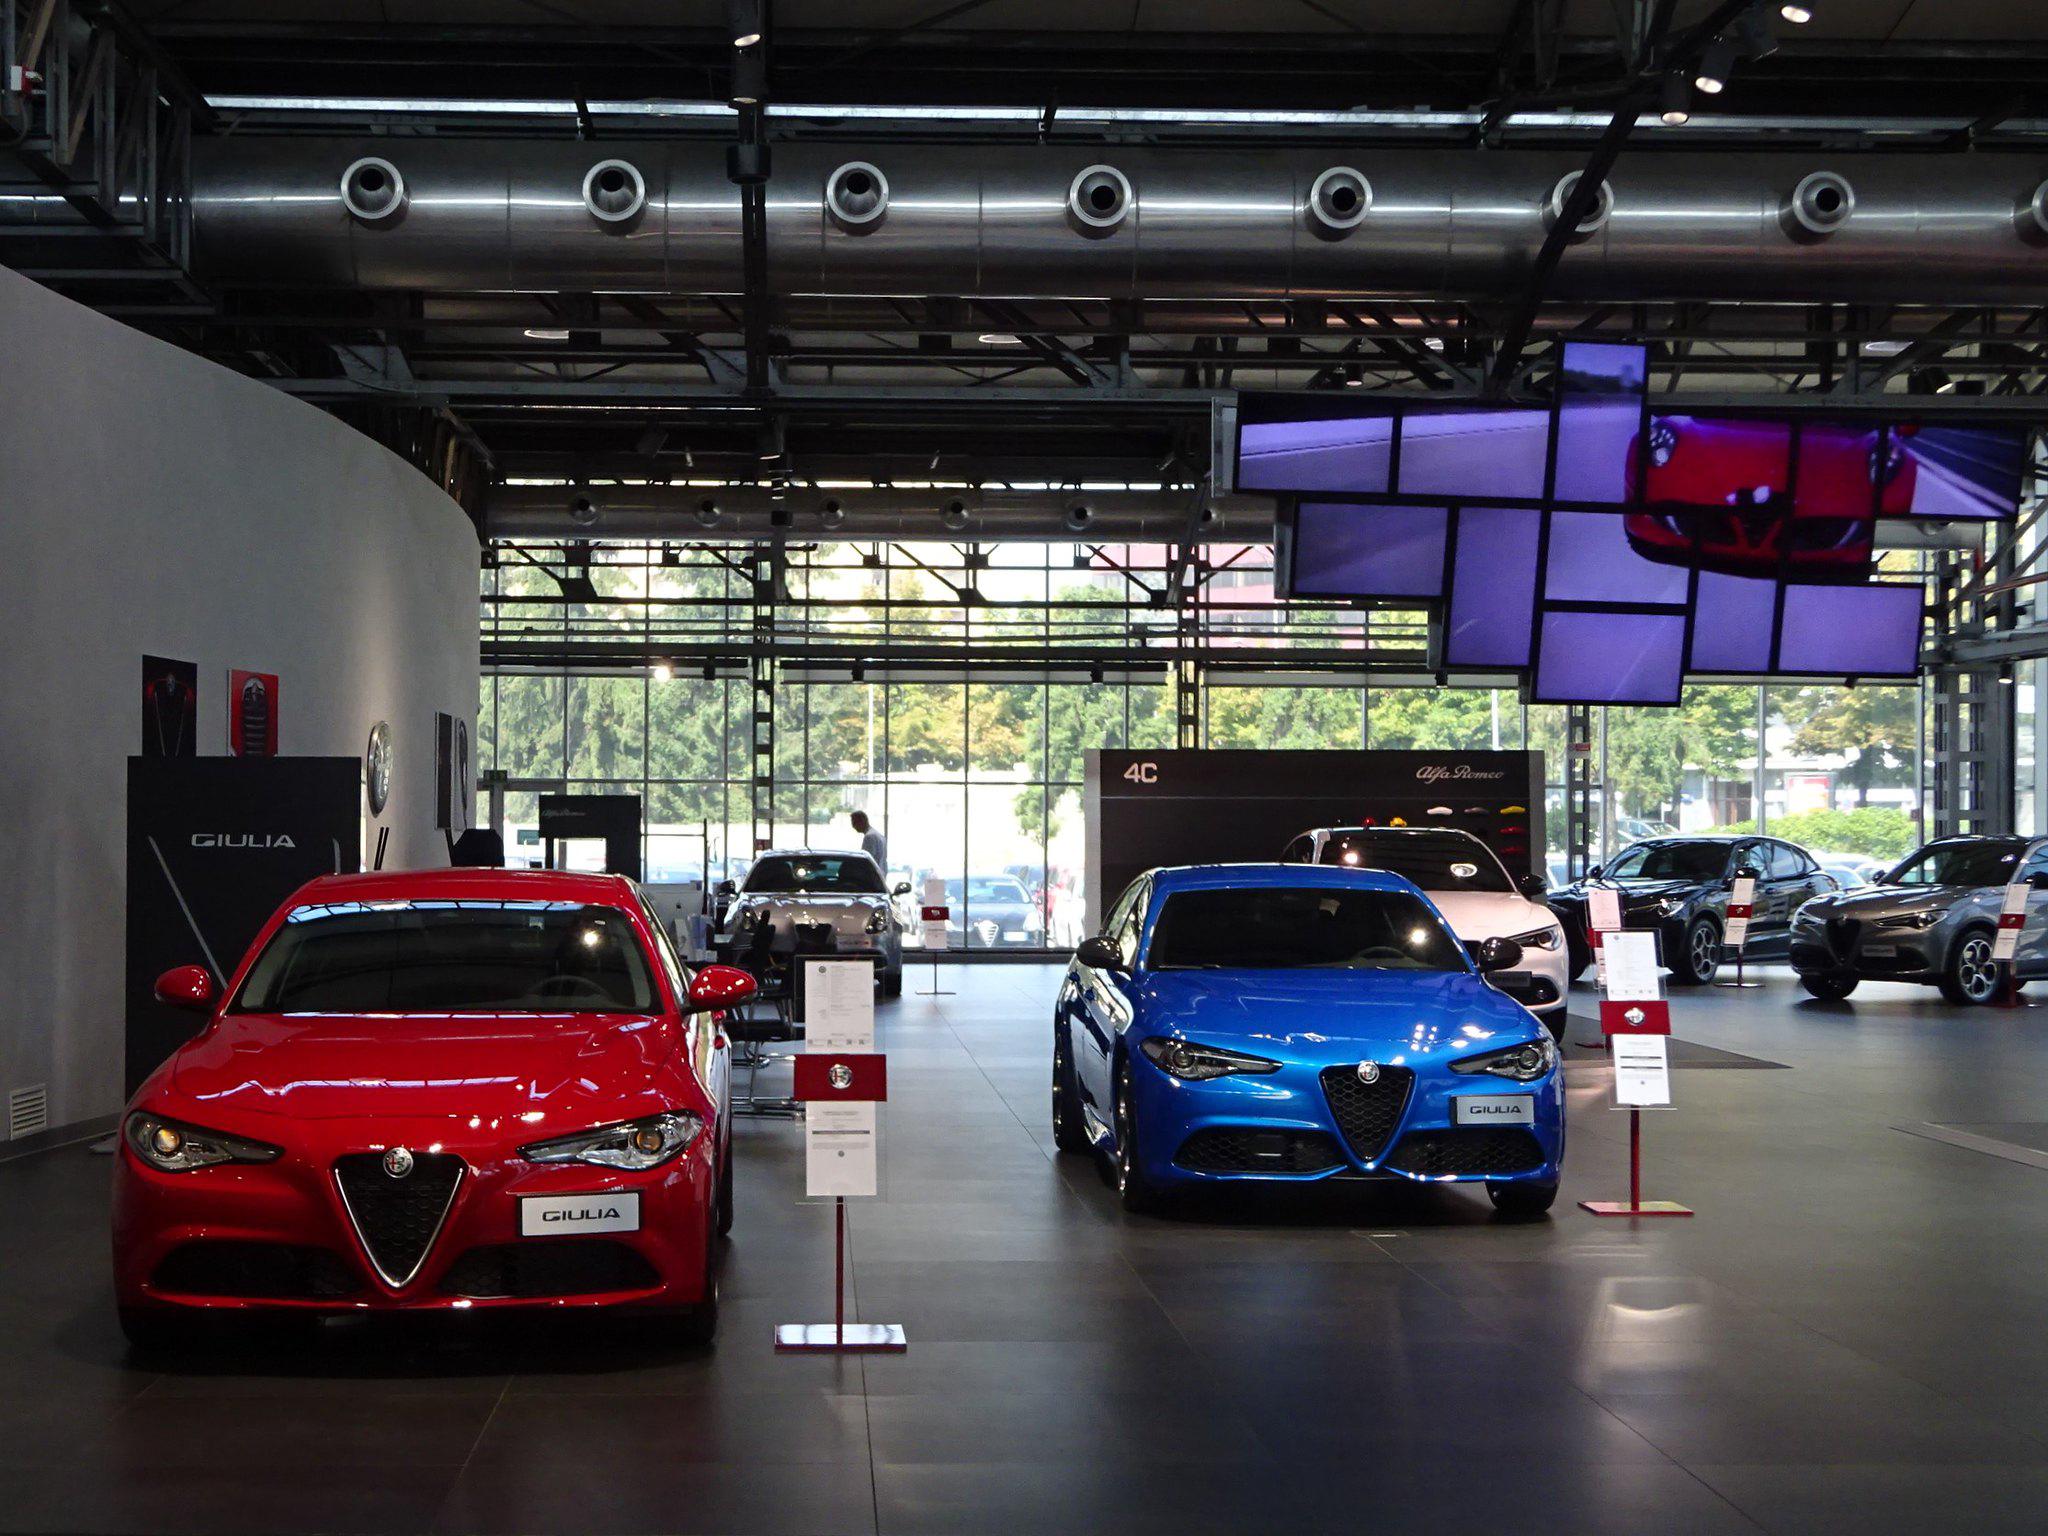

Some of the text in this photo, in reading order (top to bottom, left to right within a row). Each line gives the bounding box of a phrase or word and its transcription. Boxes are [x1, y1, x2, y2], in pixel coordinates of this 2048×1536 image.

[1123, 762, 1158, 783] 4C
[1415, 765, 1504, 784] Alfa Romeo
[191, 833, 295, 848] GIULIA
[1470, 1105, 1522, 1114] GIULIA
[542, 1207, 620, 1222] GIULIA
